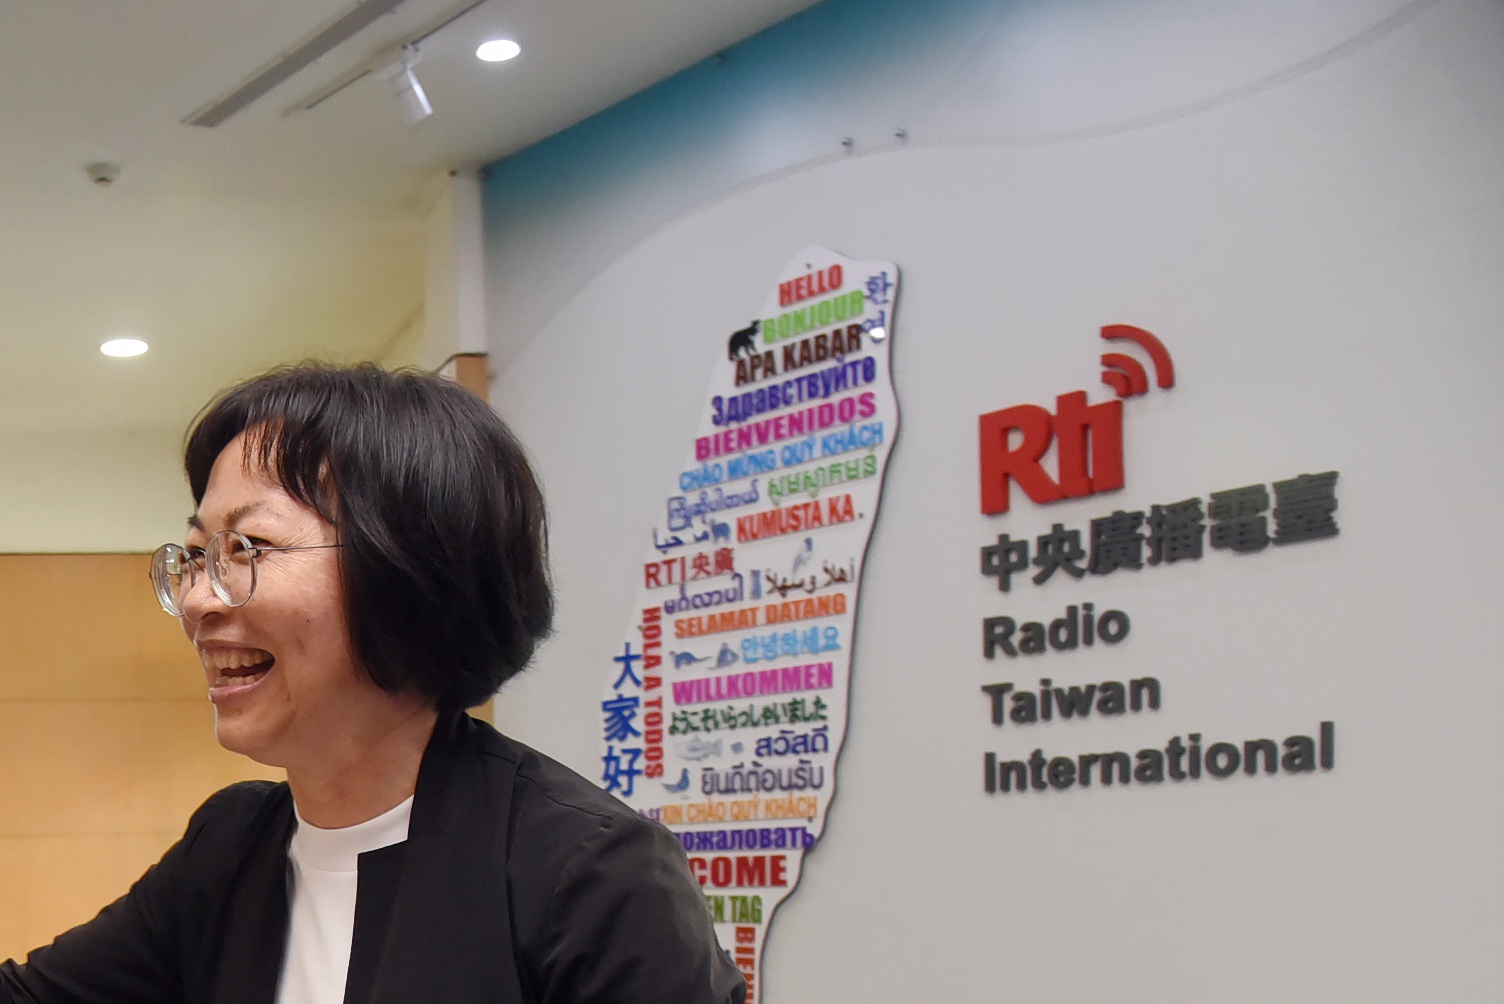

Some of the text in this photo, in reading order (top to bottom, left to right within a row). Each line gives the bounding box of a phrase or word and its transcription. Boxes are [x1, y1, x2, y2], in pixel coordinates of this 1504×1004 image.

[779, 264, 843, 307] HELLO
[762, 289, 864, 343] BONJOUR
[734, 323, 862, 387] APA KABAR
[695, 392, 876, 461] BIENVENIDOS
[736, 493, 855, 544] KUMUSTA KA
[980, 470, 1340, 592] 中央廣播電臺
[644, 556, 686, 589] RTI
[674, 593, 847, 639] SELAMAT DATANG
[982, 602, 1131, 660] Radio
[741, 625, 842, 663] 안녕하세요
[642, 606, 664, 779] HOLA A TODOS
[671, 662, 834, 706] WILLKOMMEN
[980, 675, 1161, 726] Taiwan
[601, 642, 643, 797] 大家好
[754, 725, 829, 757] สวัสดี
[701, 759, 824, 795] ยินดีต้อนรับ
[983, 720, 1335, 794] International
[688, 855, 788, 888] COME
[731, 895, 763, 924] TAG
